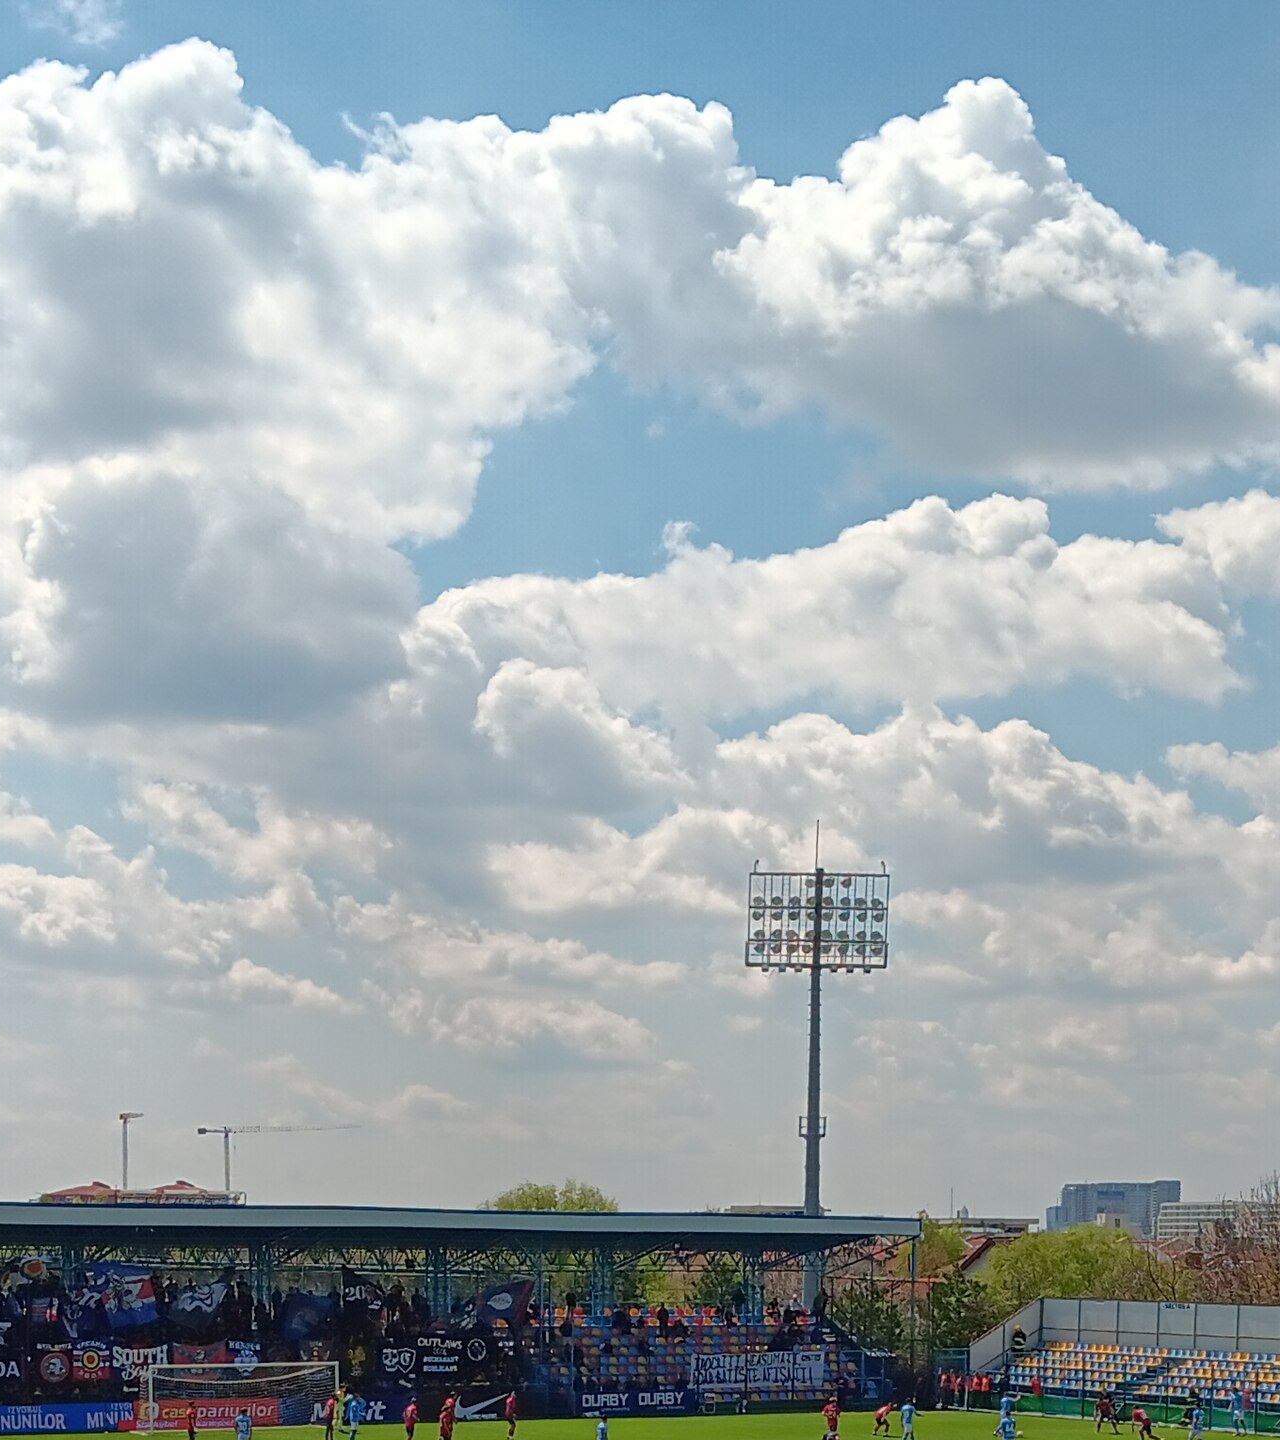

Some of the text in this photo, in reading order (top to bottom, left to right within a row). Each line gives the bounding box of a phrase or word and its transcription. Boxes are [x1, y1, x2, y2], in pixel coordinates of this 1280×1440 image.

[417, 1337, 463, 1349] OUTLAWS
[113, 1344, 168, 1368] SOUTH
[162, 1403, 275, 1420] cas pariuilor
